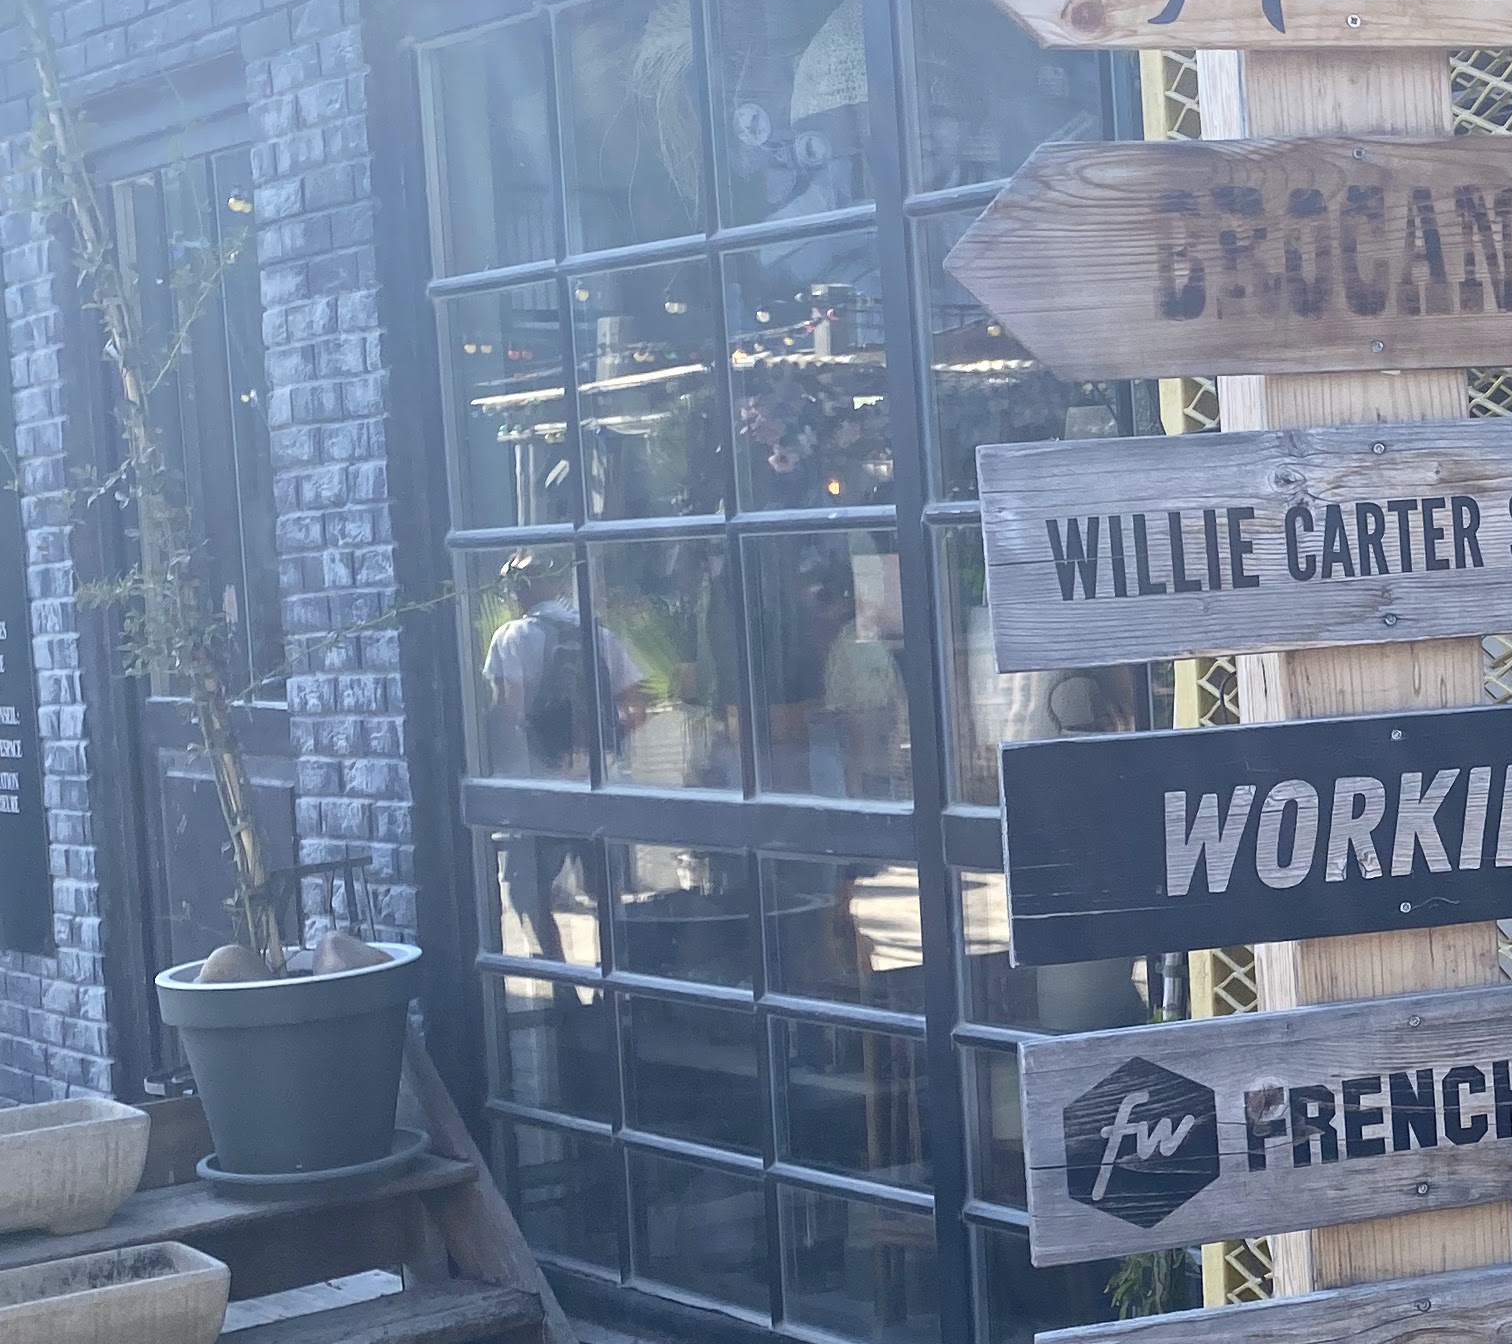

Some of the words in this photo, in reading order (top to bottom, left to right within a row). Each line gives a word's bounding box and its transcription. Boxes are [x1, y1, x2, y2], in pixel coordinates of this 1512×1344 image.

[1046, 506, 1260, 601] WILLIE
[1285, 496, 1483, 582] CARTER
[1091, 1092, 1194, 1201] fw
